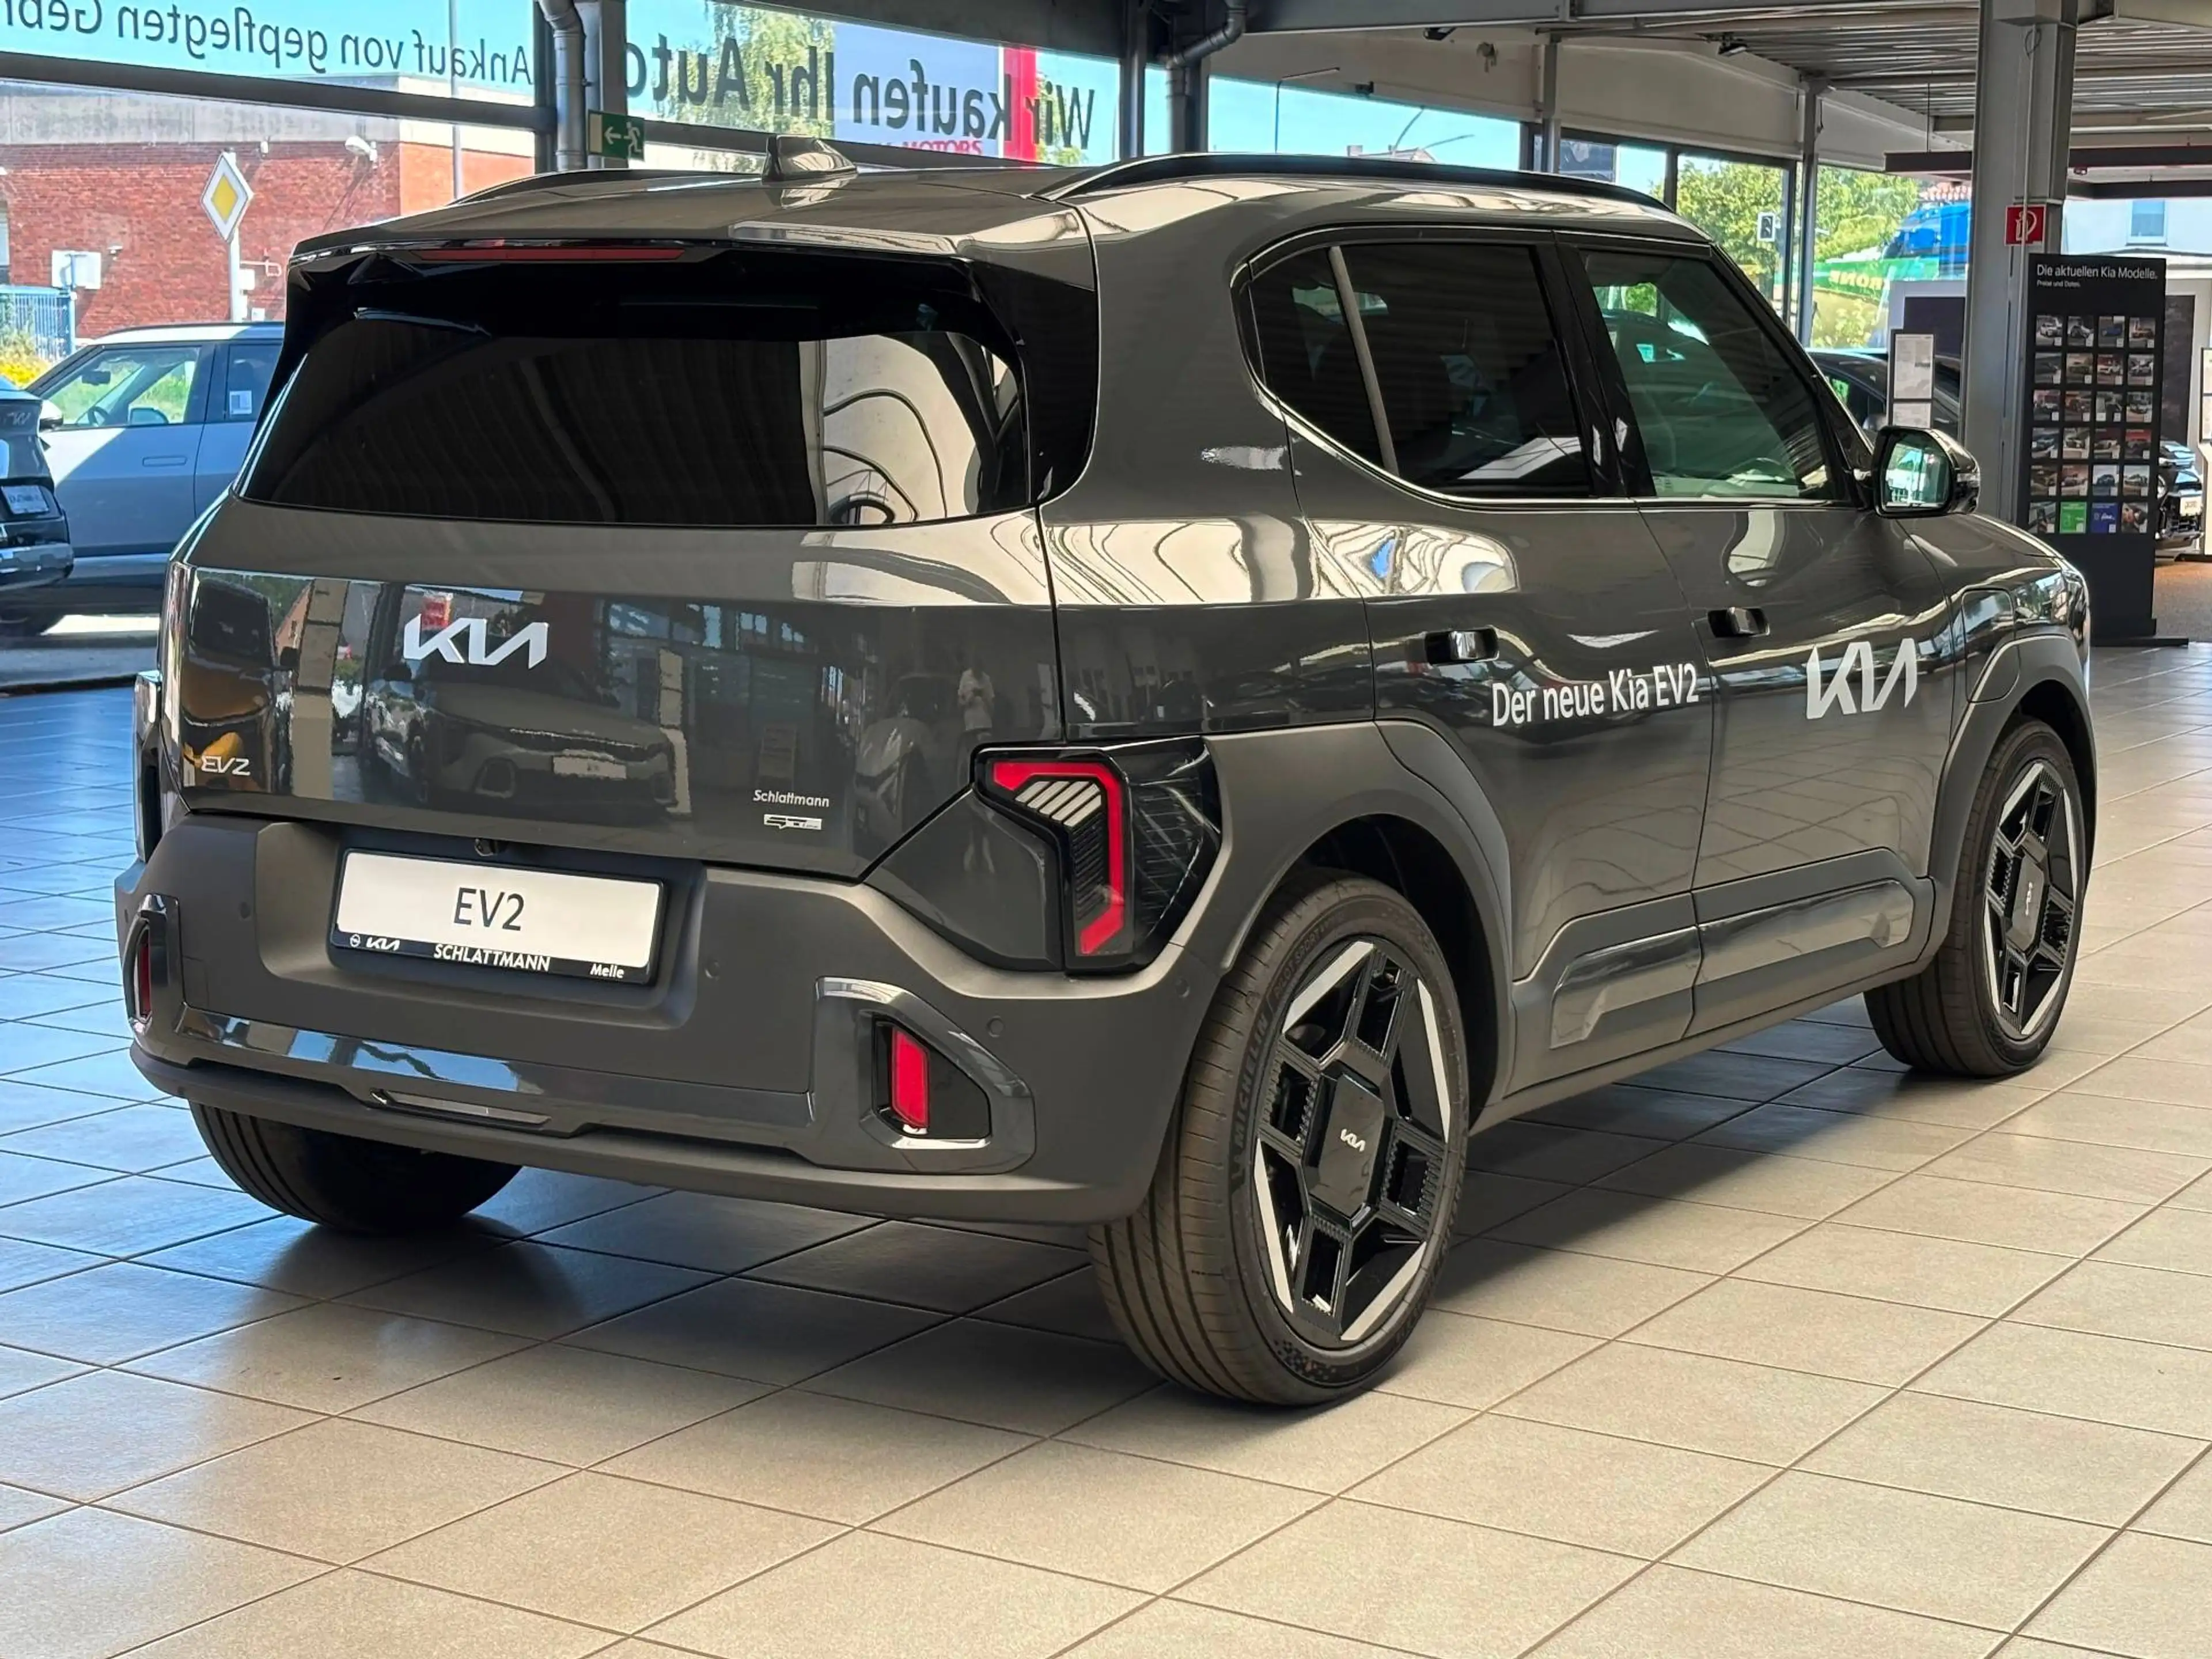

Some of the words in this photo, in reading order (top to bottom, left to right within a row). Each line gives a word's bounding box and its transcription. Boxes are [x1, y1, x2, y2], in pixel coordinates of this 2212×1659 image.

[2037, 264, 2052, 276] Die
[2055, 264, 2099, 278] aktuellen
[2101, 266, 2116, 278] Kia
[2118, 267, 2158, 279] Modelle.
[404, 613, 548, 669] KIA
[1806, 637, 1917, 720] KIA
[1493, 681, 1535, 726] Der
[1543, 683, 1604, 719] neue
[1608, 668, 1650, 711] Kia
[1654, 663, 1700, 707] EV2
[200, 756, 251, 777] EV2
[753, 790, 830, 807] Schlattmann
[453, 887, 525, 931] EV2
[366, 937, 400, 952] KIA
[433, 943, 551, 972] SCHLATTMANN
[589, 963, 625, 979] Melle
[1232, 1015, 1268, 1147] MICHELIN
